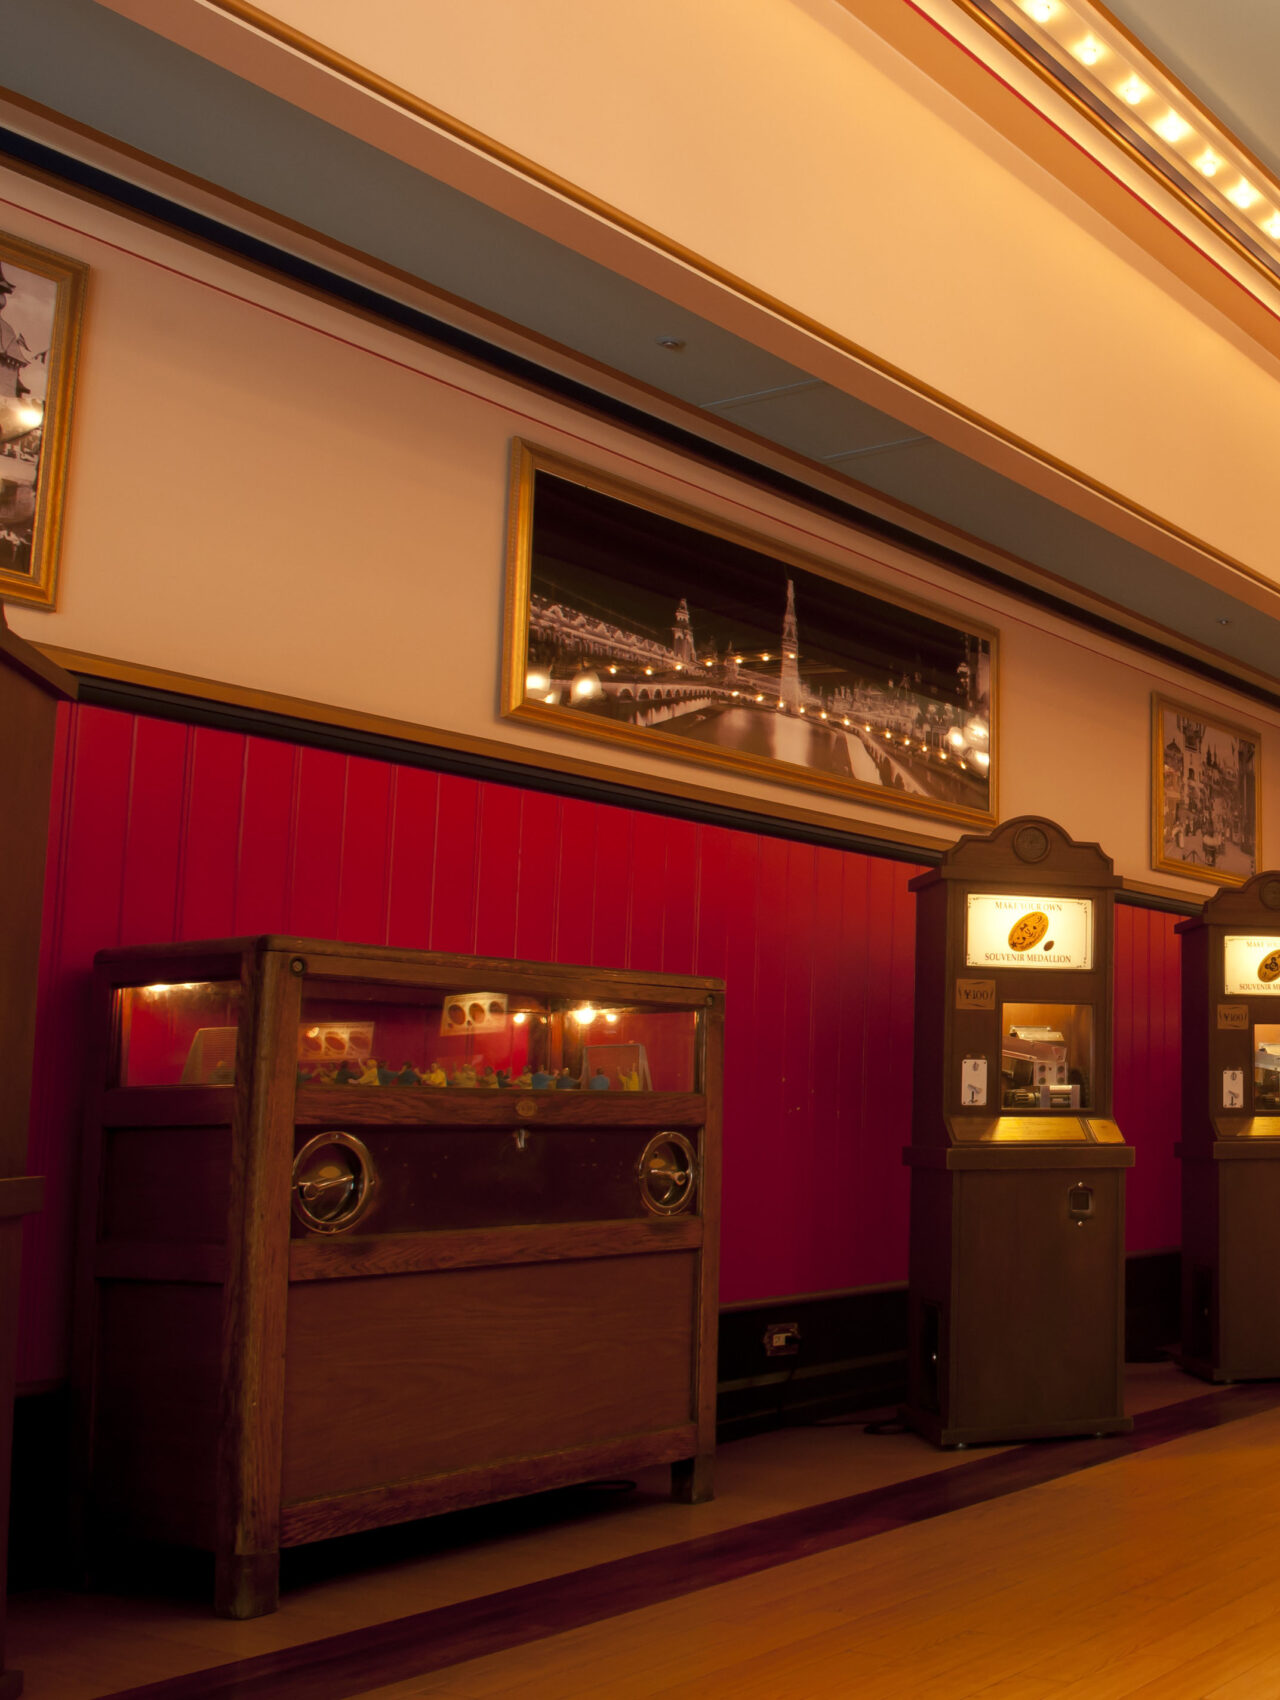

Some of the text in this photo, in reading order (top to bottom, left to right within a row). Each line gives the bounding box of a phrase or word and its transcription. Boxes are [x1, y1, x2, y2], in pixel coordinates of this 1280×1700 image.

[995, 901, 1062, 912] MAKE YOUR OWN
[1245, 940, 1264, 948] MAKE
[985, 952, 1072, 963] SOUVENIR MEDALLION
[1239, 983, 1271, 991] SOUVENIR
